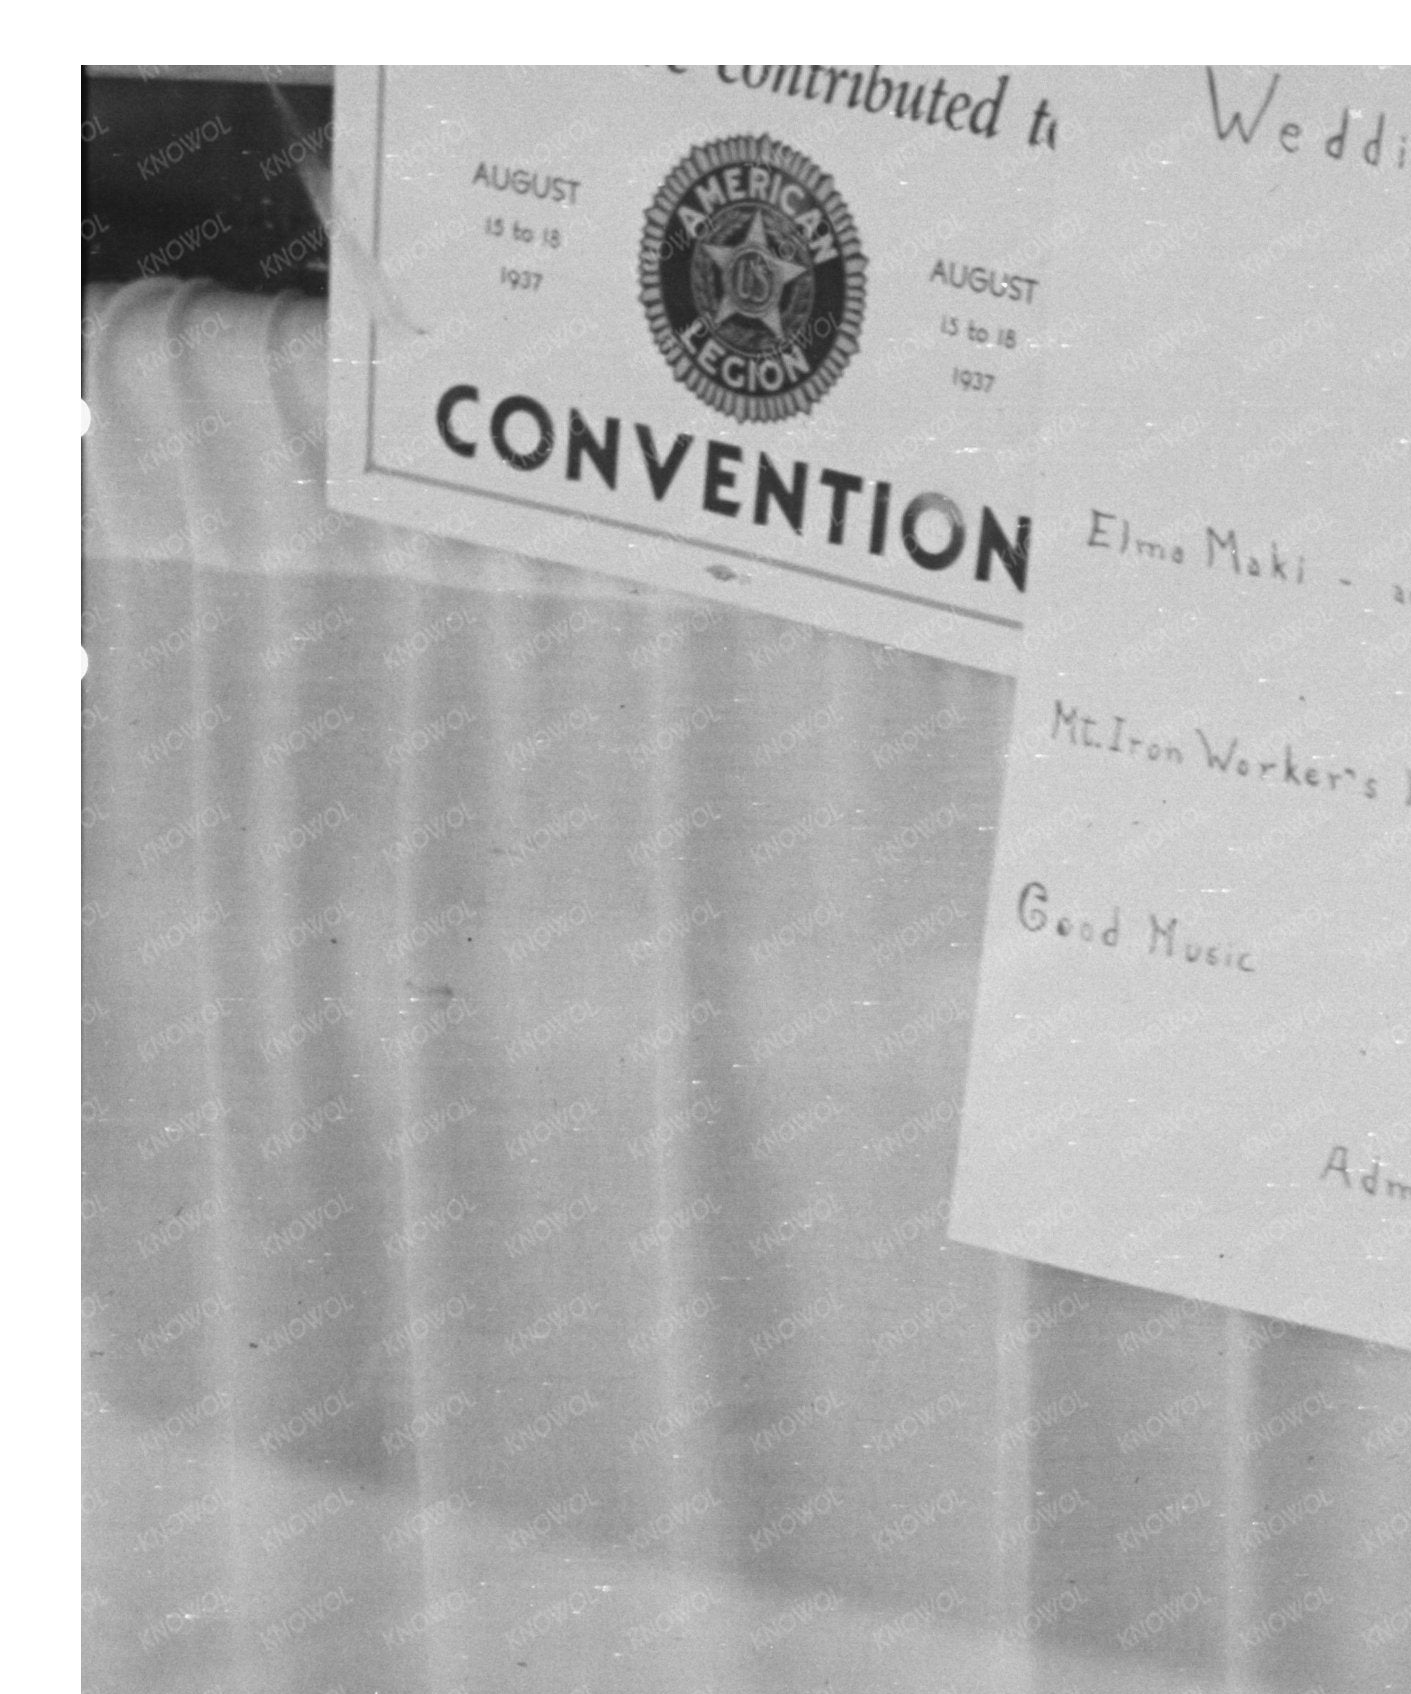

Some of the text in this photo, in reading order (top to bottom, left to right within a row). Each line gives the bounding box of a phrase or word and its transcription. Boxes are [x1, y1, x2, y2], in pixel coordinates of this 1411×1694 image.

[472, 161, 581, 205] AUGUST
[485, 217, 562, 249] 15 to 18
[677, 167, 839, 264] AMERICAN
[501, 266, 544, 292] 1937
[929, 259, 1040, 305] AUGUST
[940, 315, 1017, 349] 15 to 18
[680, 322, 811, 392] LEGION
[952, 367, 996, 393] 1937
[435, 383, 1032, 594] CONVENTION
[1017, 880, 1256, 973] Good Music
